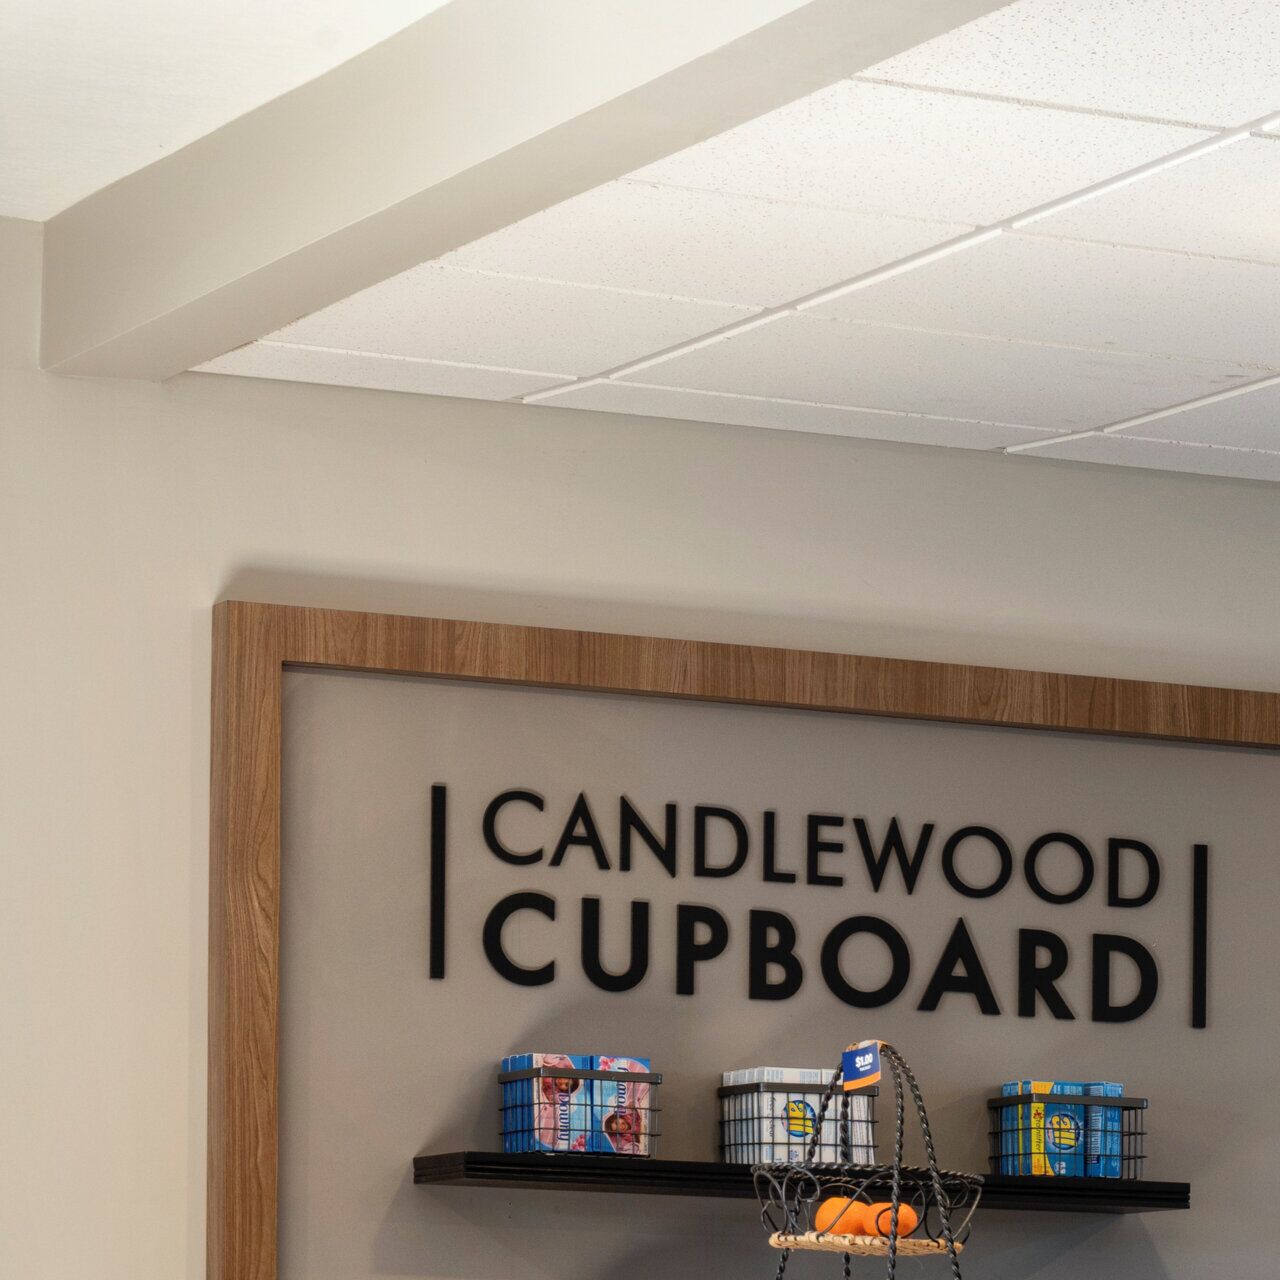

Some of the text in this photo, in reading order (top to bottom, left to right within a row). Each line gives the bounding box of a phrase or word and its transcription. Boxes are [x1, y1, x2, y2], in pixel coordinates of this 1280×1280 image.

[482, 789, 1160, 908] CANDLEWOOD
[482, 890, 1159, 1023] CUPBOARD
[856, 1053, 873, 1068] $1.00
[557, 1092, 570, 1141] Downy
